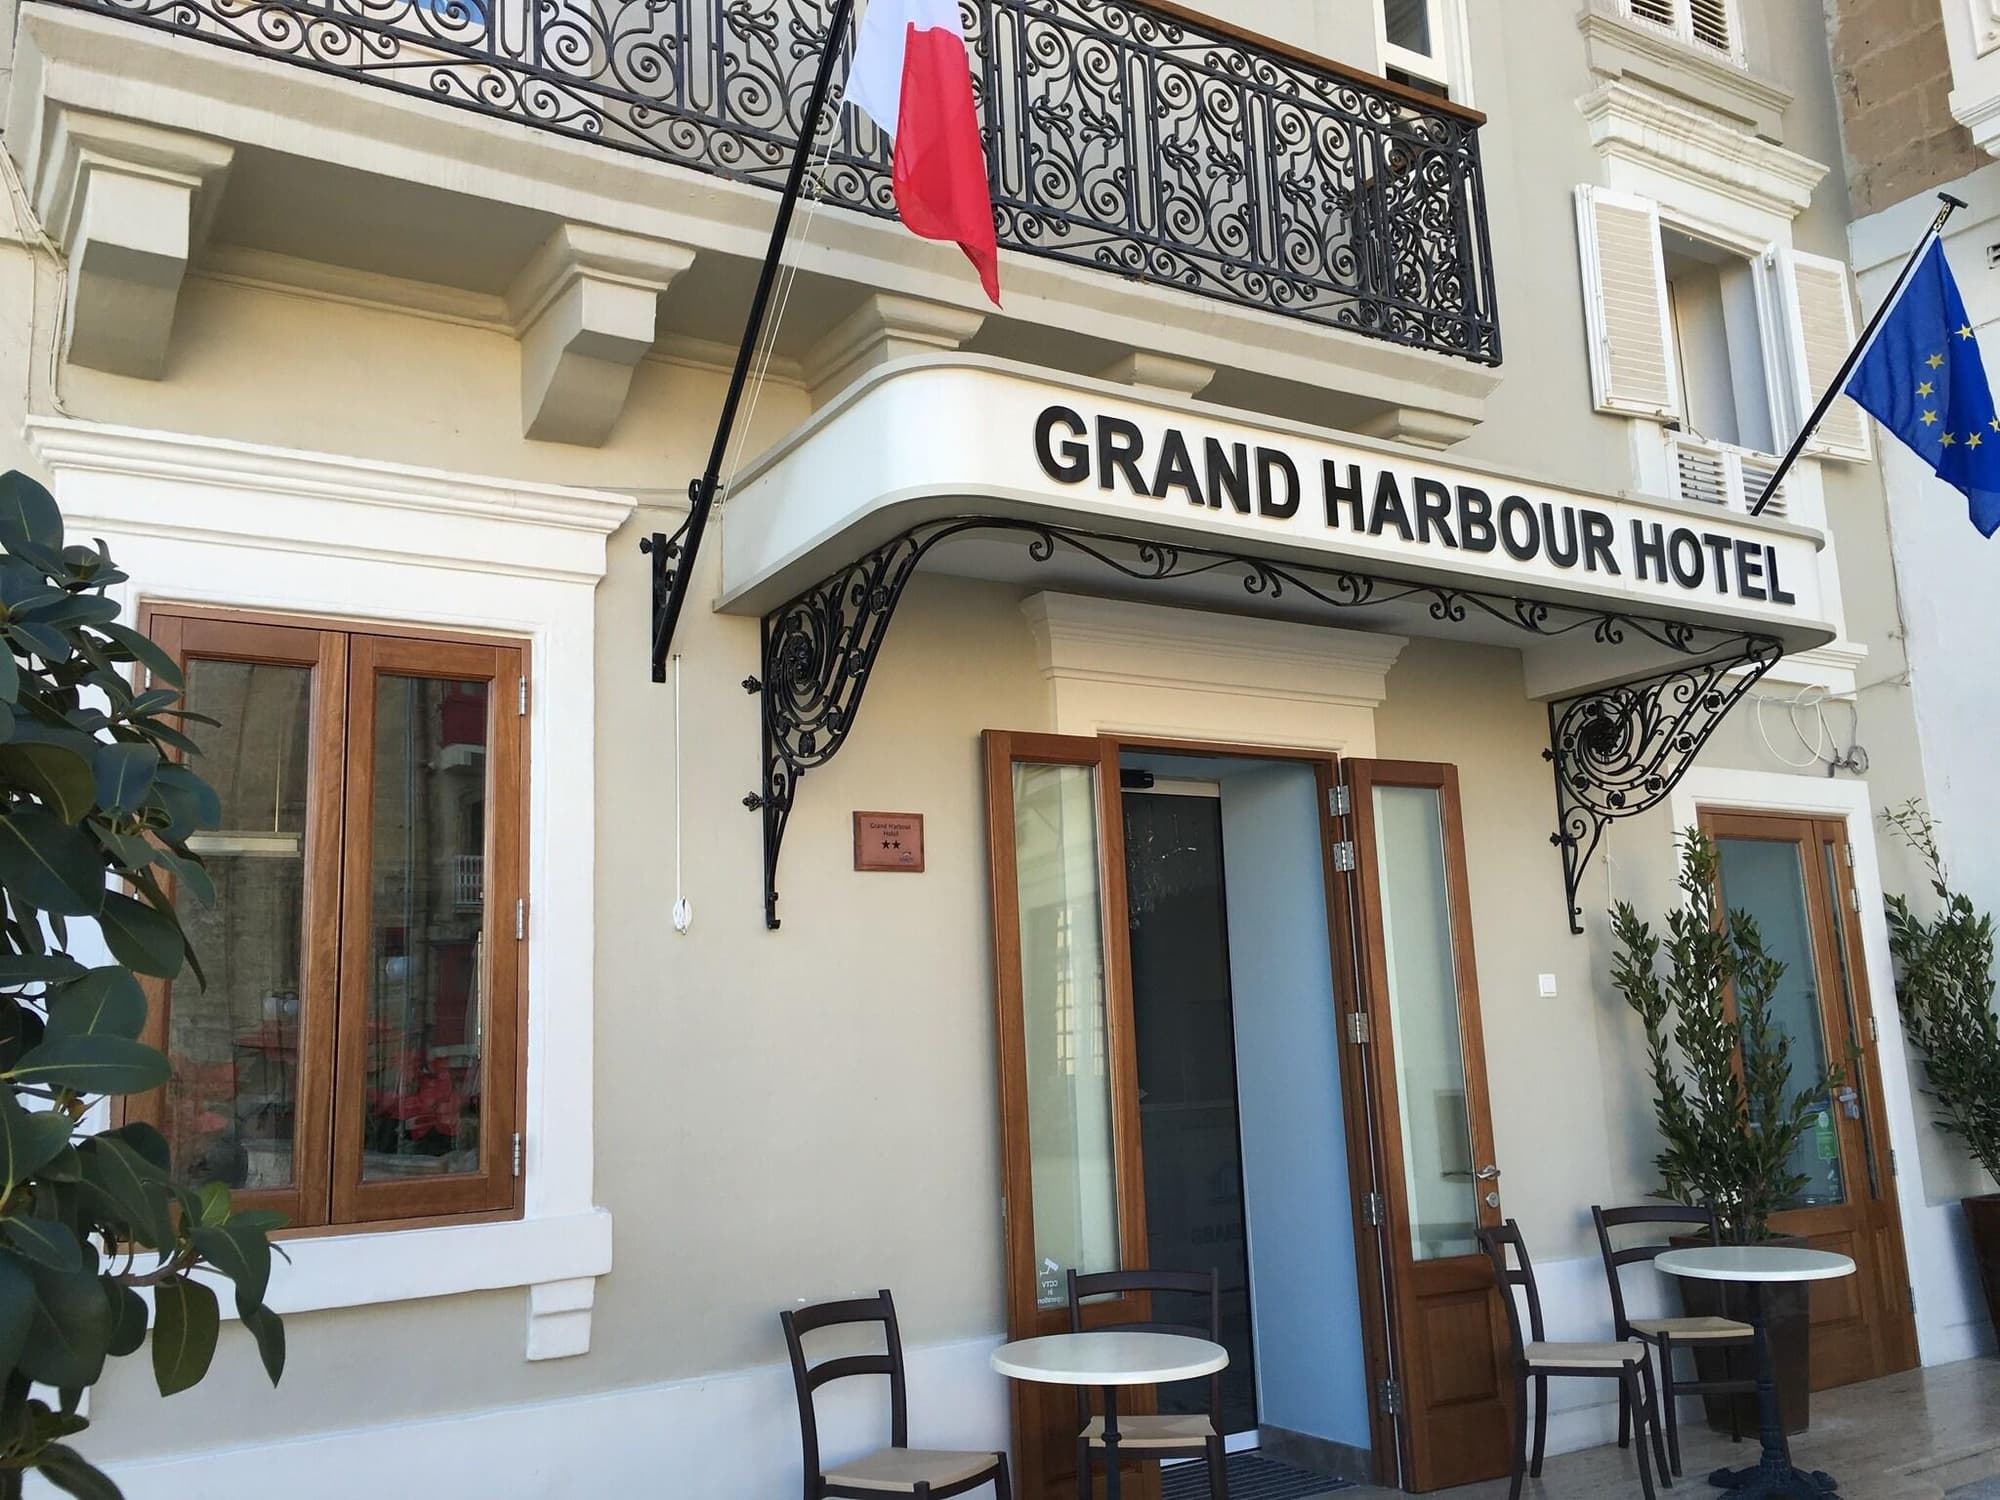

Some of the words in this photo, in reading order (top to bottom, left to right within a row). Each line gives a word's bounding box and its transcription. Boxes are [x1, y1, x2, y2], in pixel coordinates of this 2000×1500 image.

[1035, 405, 1302, 521] GRAND
[1321, 459, 1622, 576] HARBOUR
[1631, 519, 1796, 606] HOTEL
